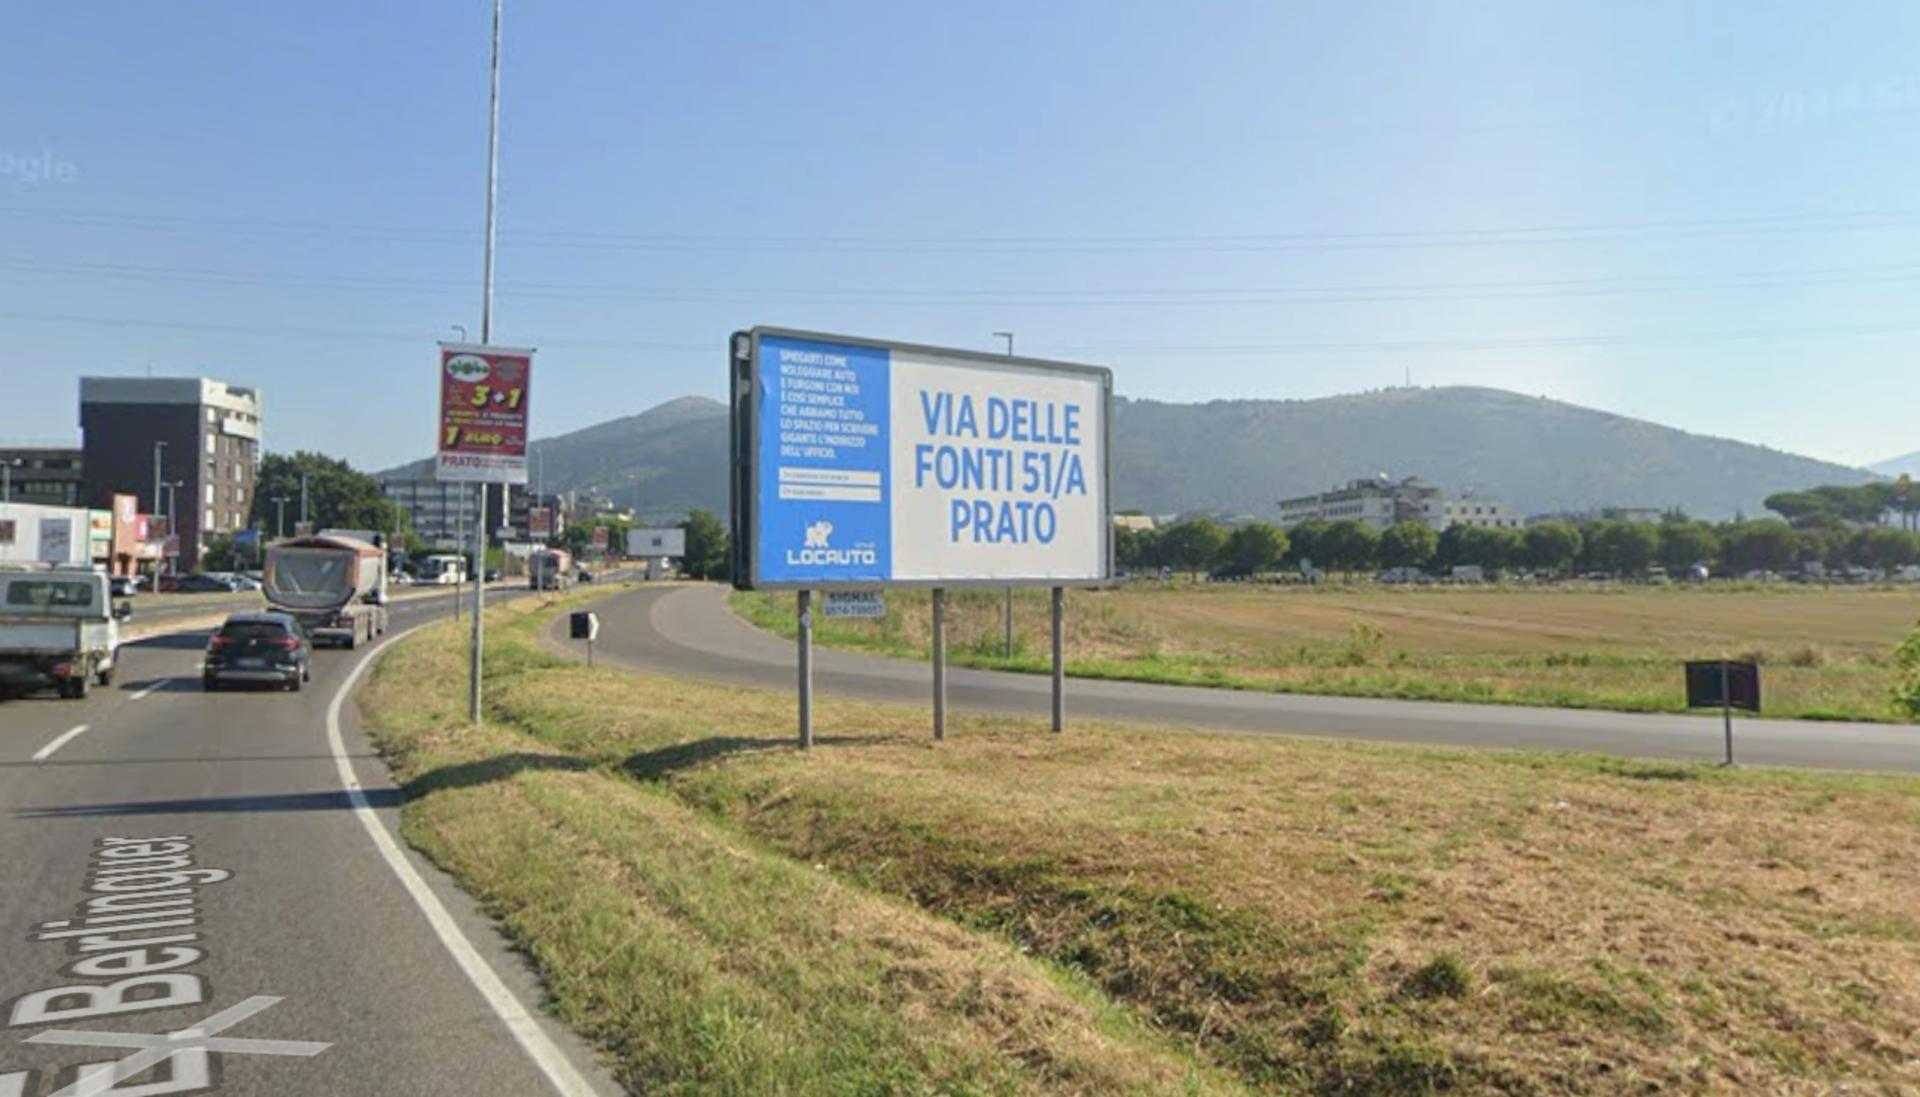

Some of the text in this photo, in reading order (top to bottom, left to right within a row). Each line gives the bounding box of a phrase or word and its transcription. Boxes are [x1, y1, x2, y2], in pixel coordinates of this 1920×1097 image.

[920, 389, 1080, 446] VIA DELLE
[916, 444, 1087, 500] FONTI 51/A
[952, 499, 1056, 544] PRATO
[787, 549, 875, 565] LOCAUTO
